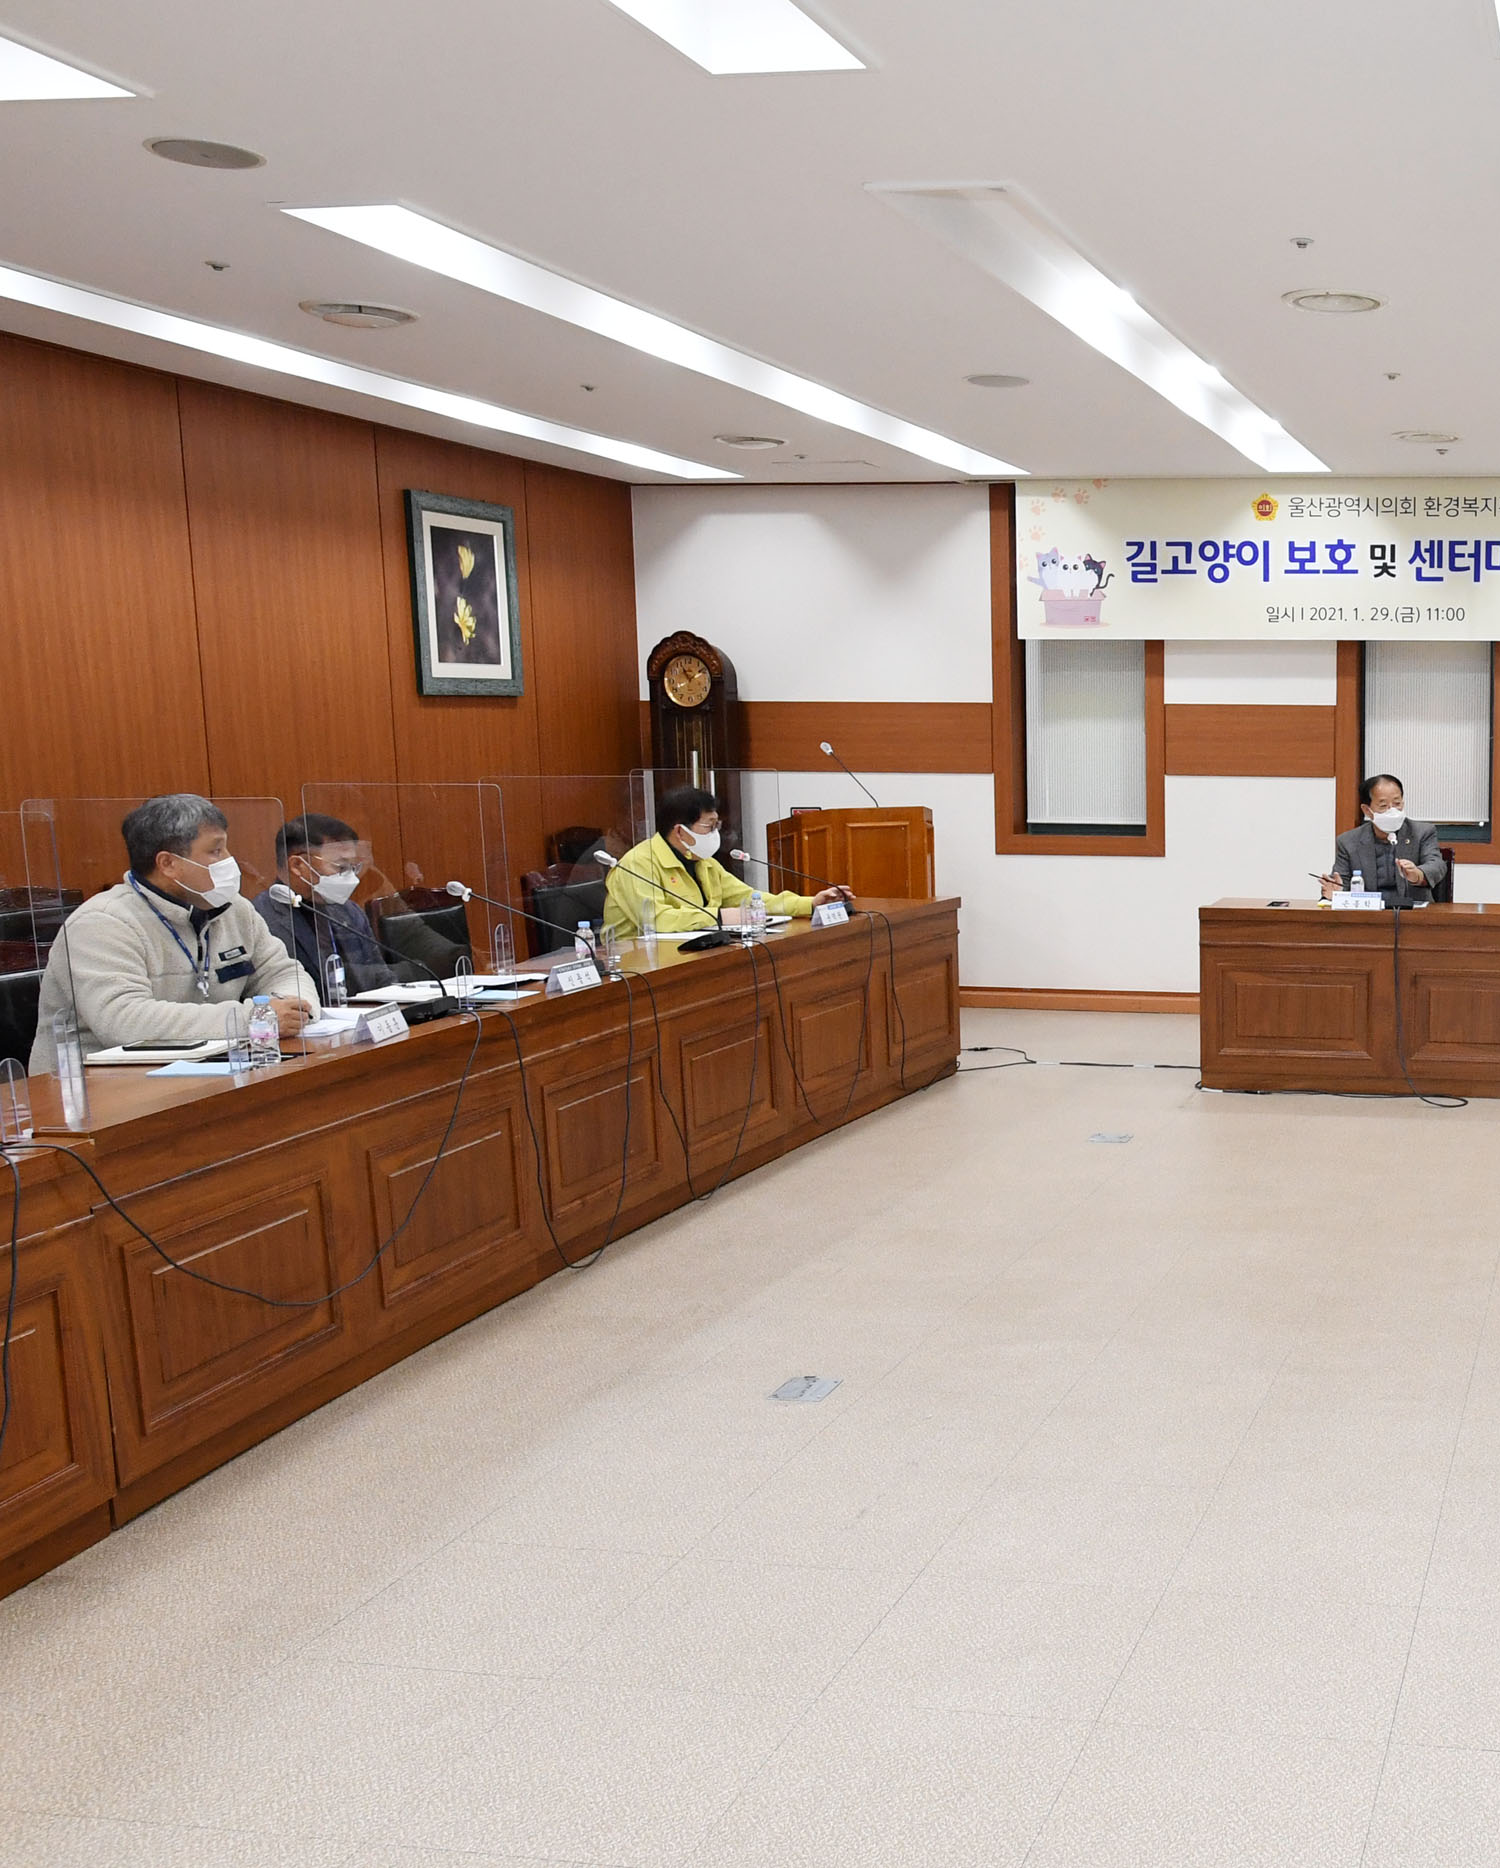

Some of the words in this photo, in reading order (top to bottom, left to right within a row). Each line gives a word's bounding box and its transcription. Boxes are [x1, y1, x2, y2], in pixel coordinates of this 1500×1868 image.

[1287, 496, 1417, 518] 울산광역시의회
[1125, 539, 1270, 584] 길고양이
[1283, 538, 1359, 576] 보호
[1369, 543, 1397, 579] 및
[1266, 606, 1295, 622] 일시
[1309, 606, 1348, 622] 2021.
[1353, 607, 1365, 622] 1.
[1426, 607, 1466, 622] 11:00
